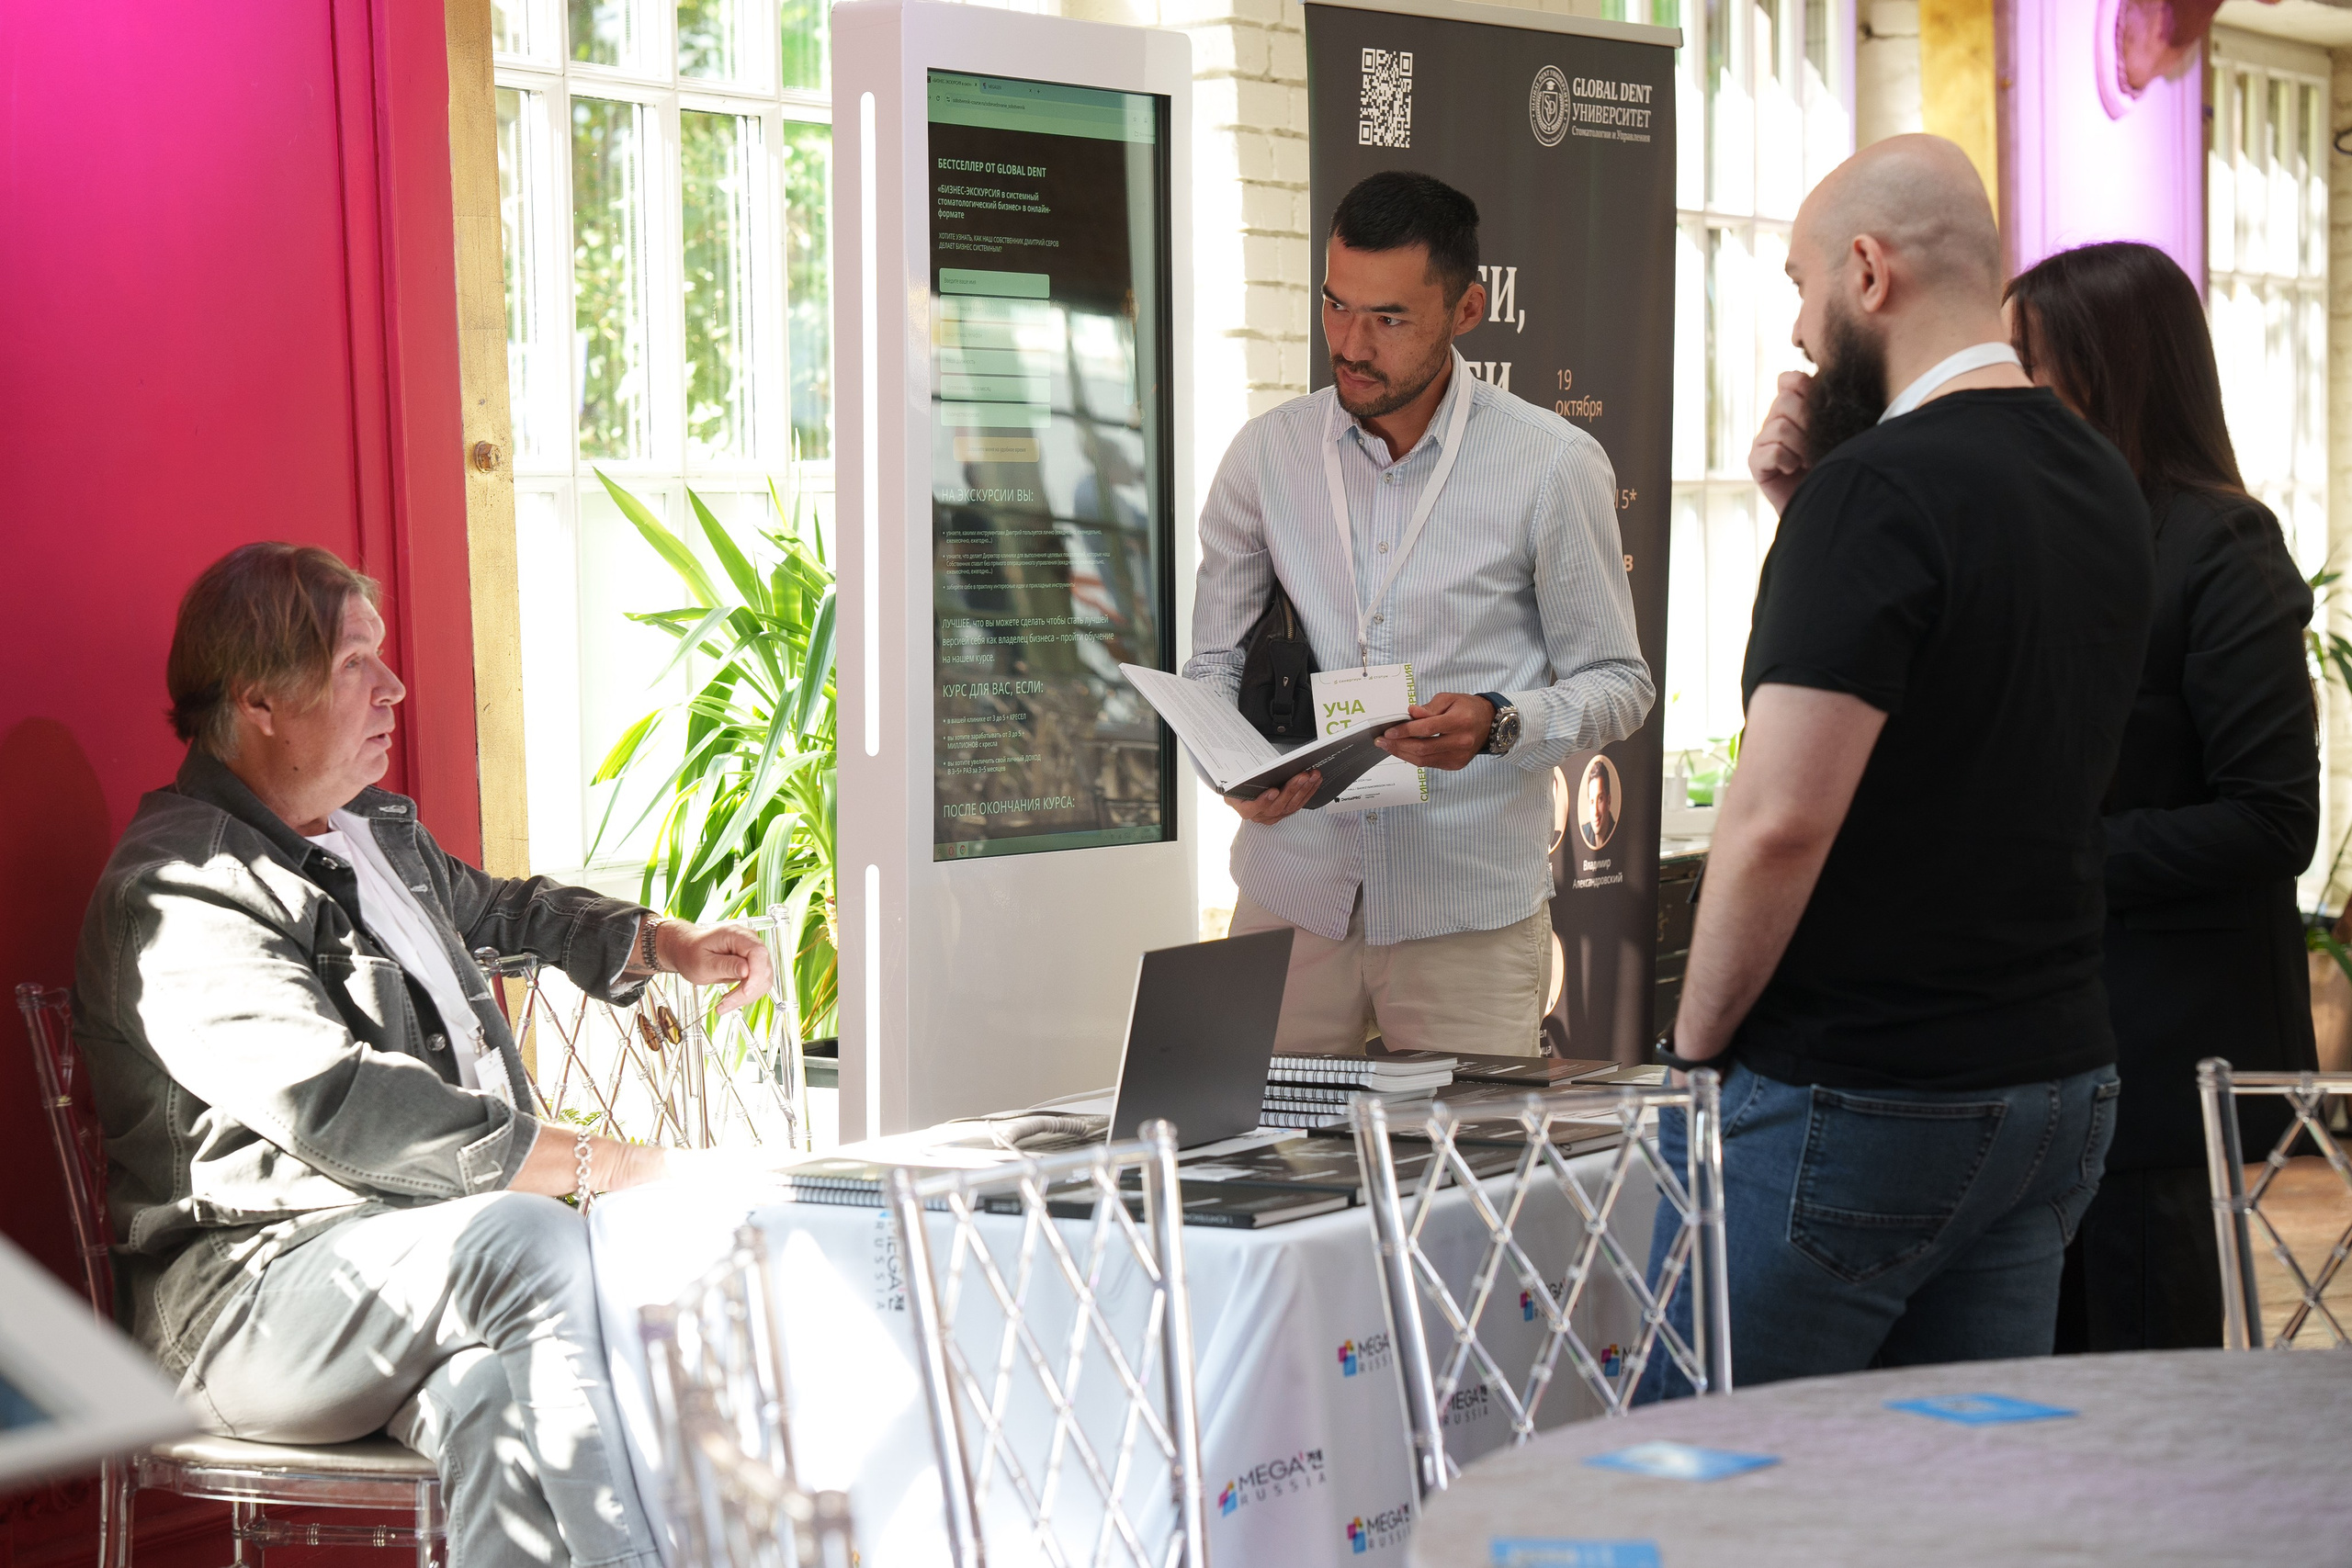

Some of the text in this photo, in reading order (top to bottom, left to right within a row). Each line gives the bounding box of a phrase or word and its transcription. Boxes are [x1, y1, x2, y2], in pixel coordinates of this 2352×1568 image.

[1572, 77, 1652, 104] GLOBAL DENT
[1572, 102, 1652, 129] УНИВЕРСИТЕТ
[1617, 130, 1651, 143] Управления
[937, 158, 1047, 178] БЕСТСЕЛЛЕР ОТ GLOBAL DENT
[937, 184, 1001, 198] «БИЗНЕС-ЭКСКУРСИЯ
[1006, 192, 1040, 201] системный
[937, 198, 997, 209] стоматологический
[998, 201, 1022, 211] бизнес»
[1027, 204, 1051, 214] онлайн-
[937, 209, 965, 220] формате
[939, 232, 956, 241] ХОТИТЕ
[1046, 240, 1059, 248] СЕРОВ
[956, 243, 972, 251] БИЗНЕС
[1477, 265, 1525, 333] И,
[1556, 369, 1572, 390] 19
[1555, 395, 1602, 423] октября
[942, 489, 1034, 502] НА ЭКСКУРСИИ ВЫ:
[942, 618, 971, 628] ЛУЧШЕЕ,
[972, 619, 984, 627] что
[995, 618, 1020, 626] можете
[1020, 617, 1046, 628] сделать
[1046, 615, 1066, 626] чтобы
[1067, 616, 1084, 625] стать
[1084, 614, 1109, 626] лучшей
[942, 636, 969, 649] версией
[970, 635, 985, 645] себя
[998, 636, 1029, 645] владелец
[1029, 633, 1055, 643] бизнеса
[1060, 632, 1083, 644] пройти
[1084, 631, 1114, 643] обучение
[952, 654, 975, 663] нашем
[975, 654, 995, 665] курсе.
[943, 680, 1044, 699] КУРС ДЛЯ ВАС, ЕСЛИ:
[1404, 663, 1417, 705] РЕНЦИЯ
[1323, 699, 1366, 718] УЧА
[947, 741, 978, 750] МИЛЛИОНОВ
[1417, 767, 1429, 802] СИНЕР
[944, 795, 1075, 818] ПОСЛЕ ОКОНЧАНИЯ КУРСА:
[1582, 859, 1611, 872] Владимир
[1572, 872, 1623, 889] Александровский
